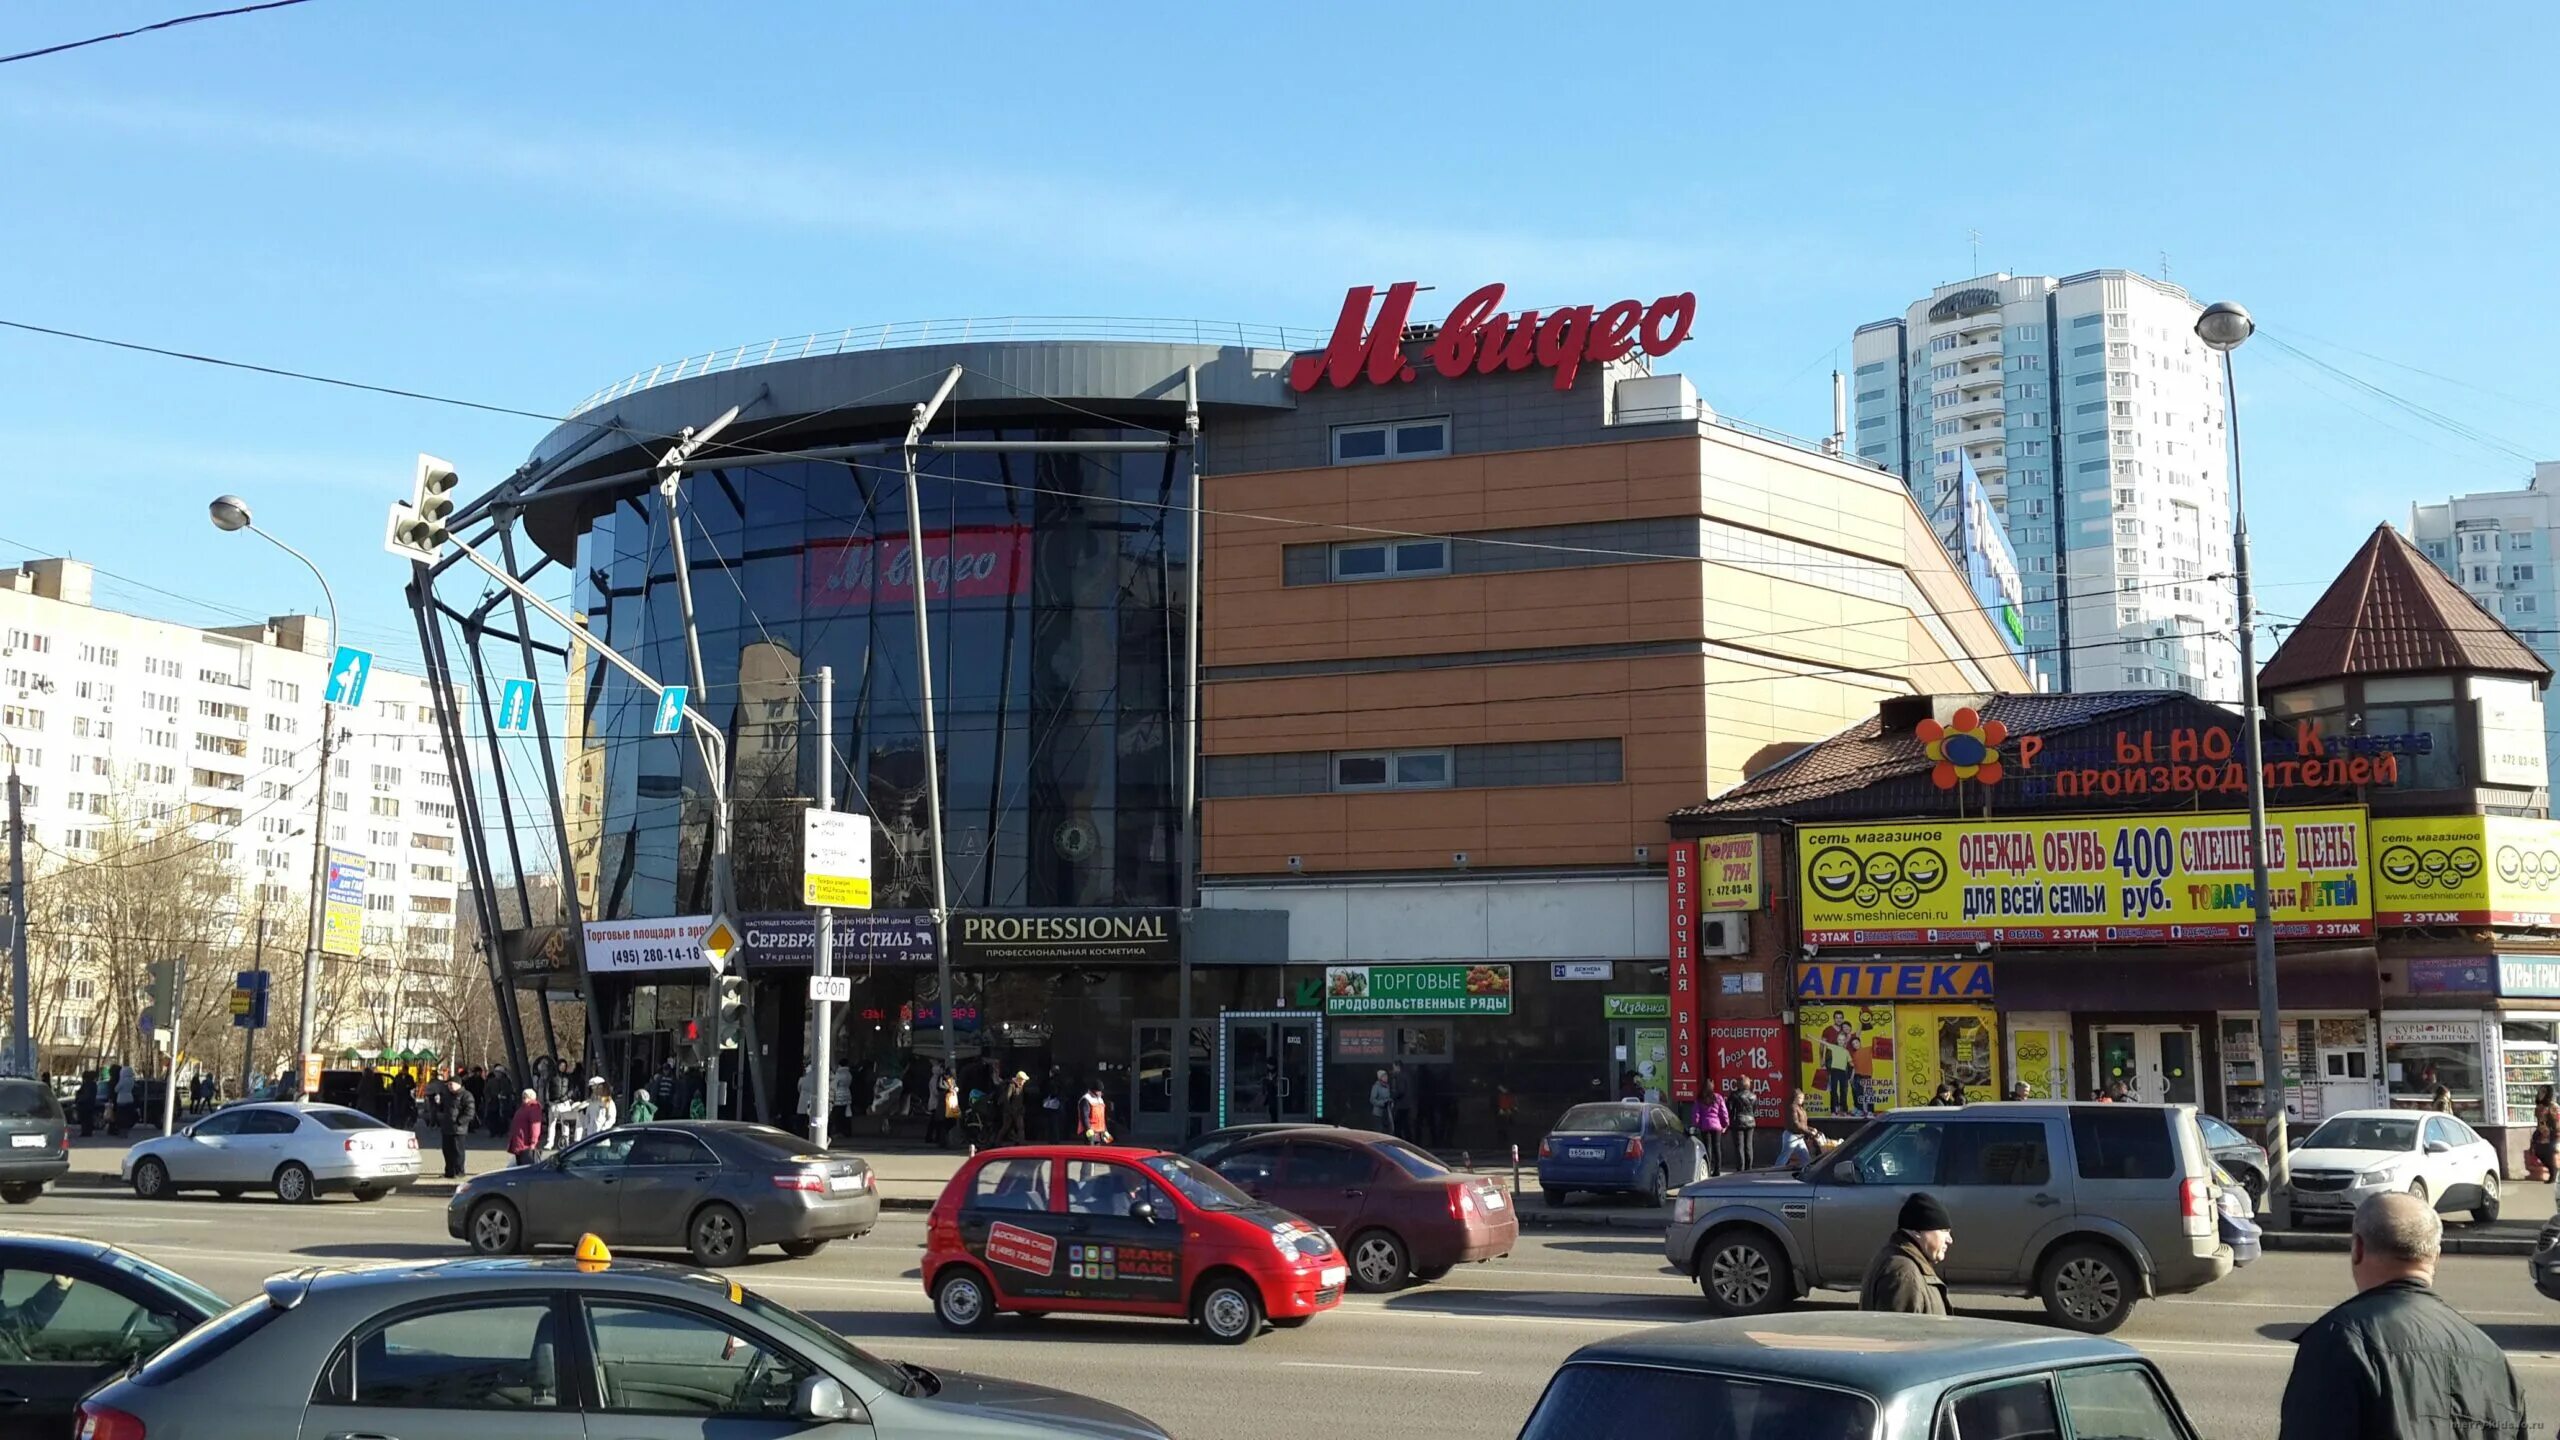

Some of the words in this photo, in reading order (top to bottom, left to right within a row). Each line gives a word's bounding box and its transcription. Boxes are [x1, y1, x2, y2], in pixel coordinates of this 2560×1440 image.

[1289, 281, 1696, 392] М.видео
[1809, 833, 1850, 845] сеть
[1856, 831, 1942, 845] магазинов
[2416, 833, 2481, 842] магазинов
[1959, 834, 2036, 877] ОДЕЖДА
[2044, 831, 2106, 873] ОБУВЬ
[2113, 827, 2174, 878] 400
[2295, 825, 2358, 874] ЦЕНЫ
[1723, 862, 1752, 882] ТУРЫ
[1963, 887, 1996, 920] ДЛЯ
[2001, 881, 2044, 915] ВСЕЙ
[2050, 883, 2106, 914] СЕМЬИ
[2122, 879, 2172, 919] руб.
[2300, 873, 2358, 913] ДЕТЕЙ
[856, 917, 889, 925] НИЗКИМ
[1676, 850, 1688, 991] ЦВЕТОЧНАЯ
[1813, 909, 1949, 924] www.smeshnieceni.ru
[2403, 914, 2412, 922] 2
[2416, 913, 2460, 922] ЭТАЖ
[586, 928, 631, 944] Торговые
[633, 926, 677, 941] площади
[679, 928, 685, 937] в
[746, 928, 855, 948] СЕРЕБРЯЫЙ
[860, 931, 913, 947] СТИЛЬ
[964, 916, 1168, 940] PROFESSIONAL
[1811, 933, 1818, 942] 2
[1820, 932, 1849, 942] ЭТАЖ
[2008, 930, 2044, 939] ОБУВЬ
[2053, 929, 2061, 938] 2
[2063, 928, 2099, 938] ЭТАЖ
[2316, 925, 2324, 934] 2
[2326, 924, 2361, 934] ЭТАЖ
[611, 948, 640, 966] (495)
[643, 946, 701, 962] 280-14-18
[899, 952, 908, 960] 2
[986, 948, 1087, 957] ПРОФЕССИОНАЛЬНАЯ
[1089, 947, 1146, 956] КОСМЕТИКА
[816, 982, 845, 996] СТОП
[1374, 973, 1462, 990] ТОРГОВЫЕ
[1798, 964, 1993, 996] АПТЕКА
[1330, 998, 1466, 1012] ПРОДОВОЛЬСТВЕННЫЕ
[1470, 998, 1507, 1010] РЯДЫ
[1679, 1011, 1689, 1073] БАЗА
[1711, 1027, 1780, 1039] РОСЦВЕТТОРГ
[1718, 1047, 1726, 1069] 1
[1726, 1049, 1747, 1064] РОЗА
[1748, 1046, 1768, 1069] 18
[1722, 1078, 1771, 1094] ВСДА
